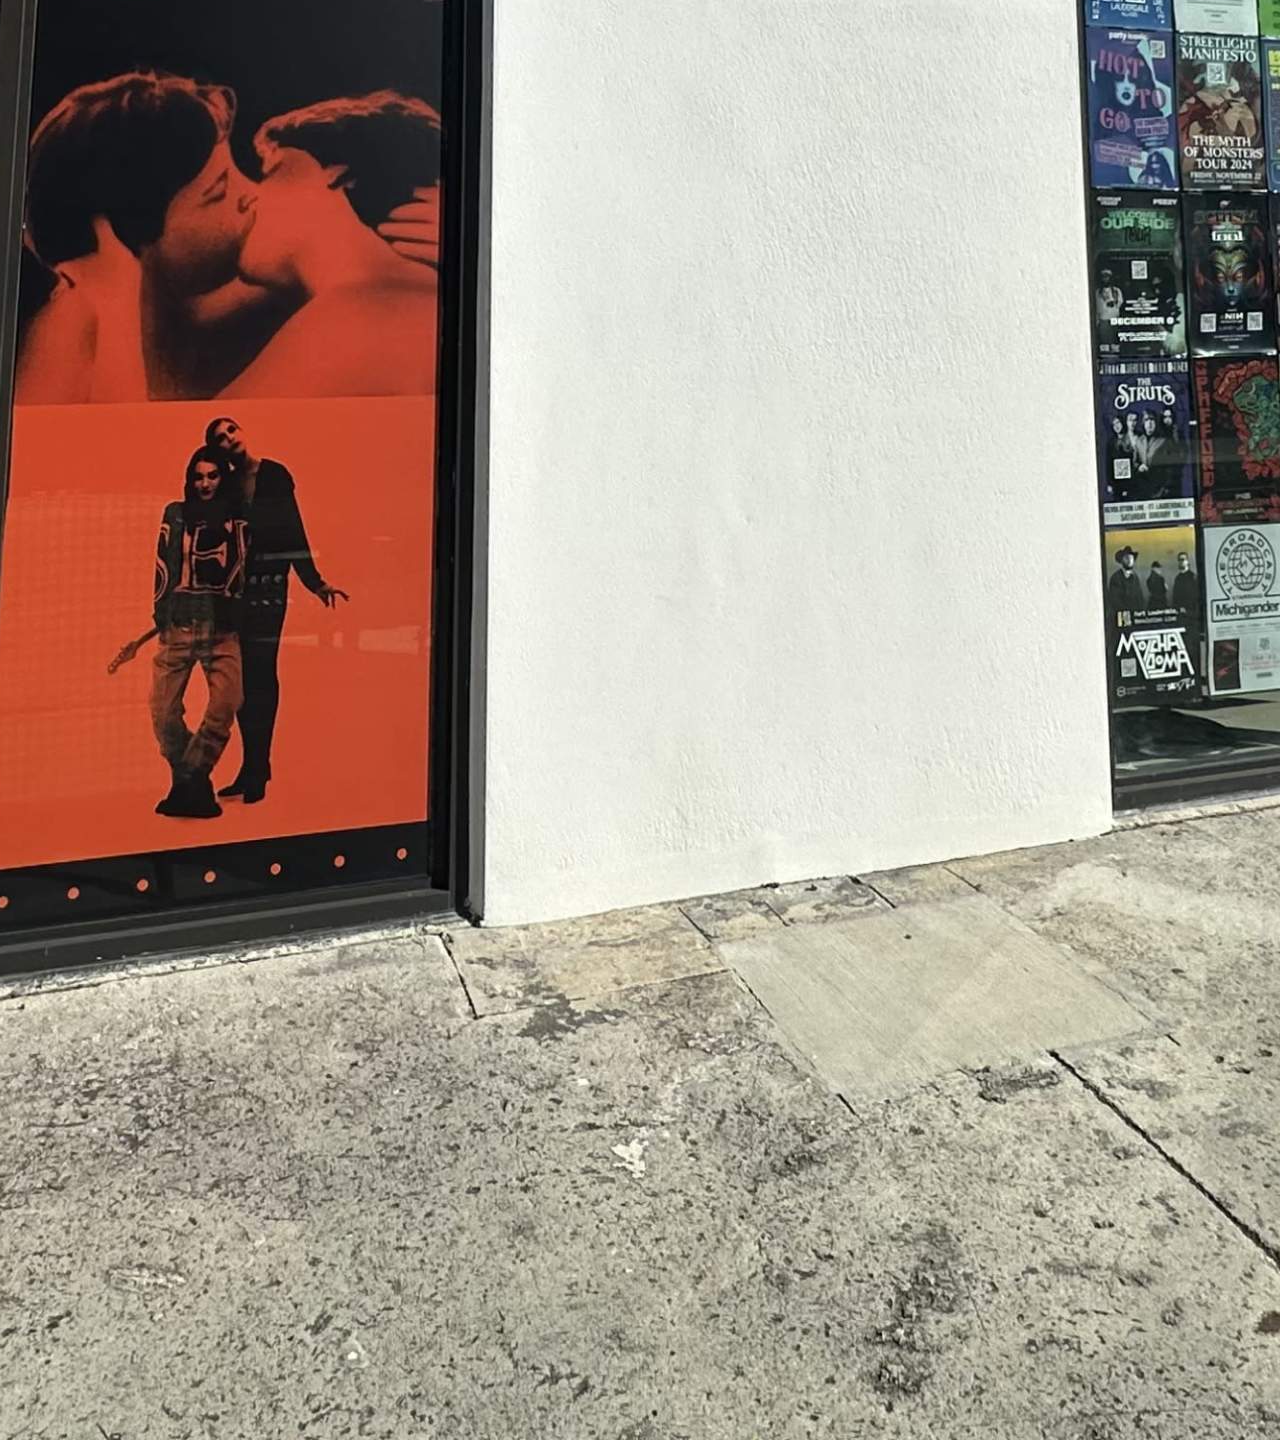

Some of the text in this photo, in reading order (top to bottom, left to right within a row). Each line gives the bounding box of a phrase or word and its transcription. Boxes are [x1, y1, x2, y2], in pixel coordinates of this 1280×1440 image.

[1180, 35, 1256, 51] STREETLIGHT
[1180, 47, 1257, 62] MANIFESTO
[1098, 48, 1145, 79] HOT
[1135, 88, 1166, 109] TO
[1099, 107, 1131, 133] GO
[1192, 134, 1252, 147] THE MYTH
[1184, 146, 1199, 157] OF
[1202, 147, 1264, 159] MONSTERS
[1195, 158, 1252, 170] TOUR 2024
[1101, 217, 1134, 230] OUR
[1110, 317, 1164, 326] DECEMBER
[1136, 377, 1153, 386] THE
[1114, 384, 1176, 410] STRUTS
[1222, 533, 1274, 592] BROADCAST
[1215, 600, 1280, 618] Michigander
